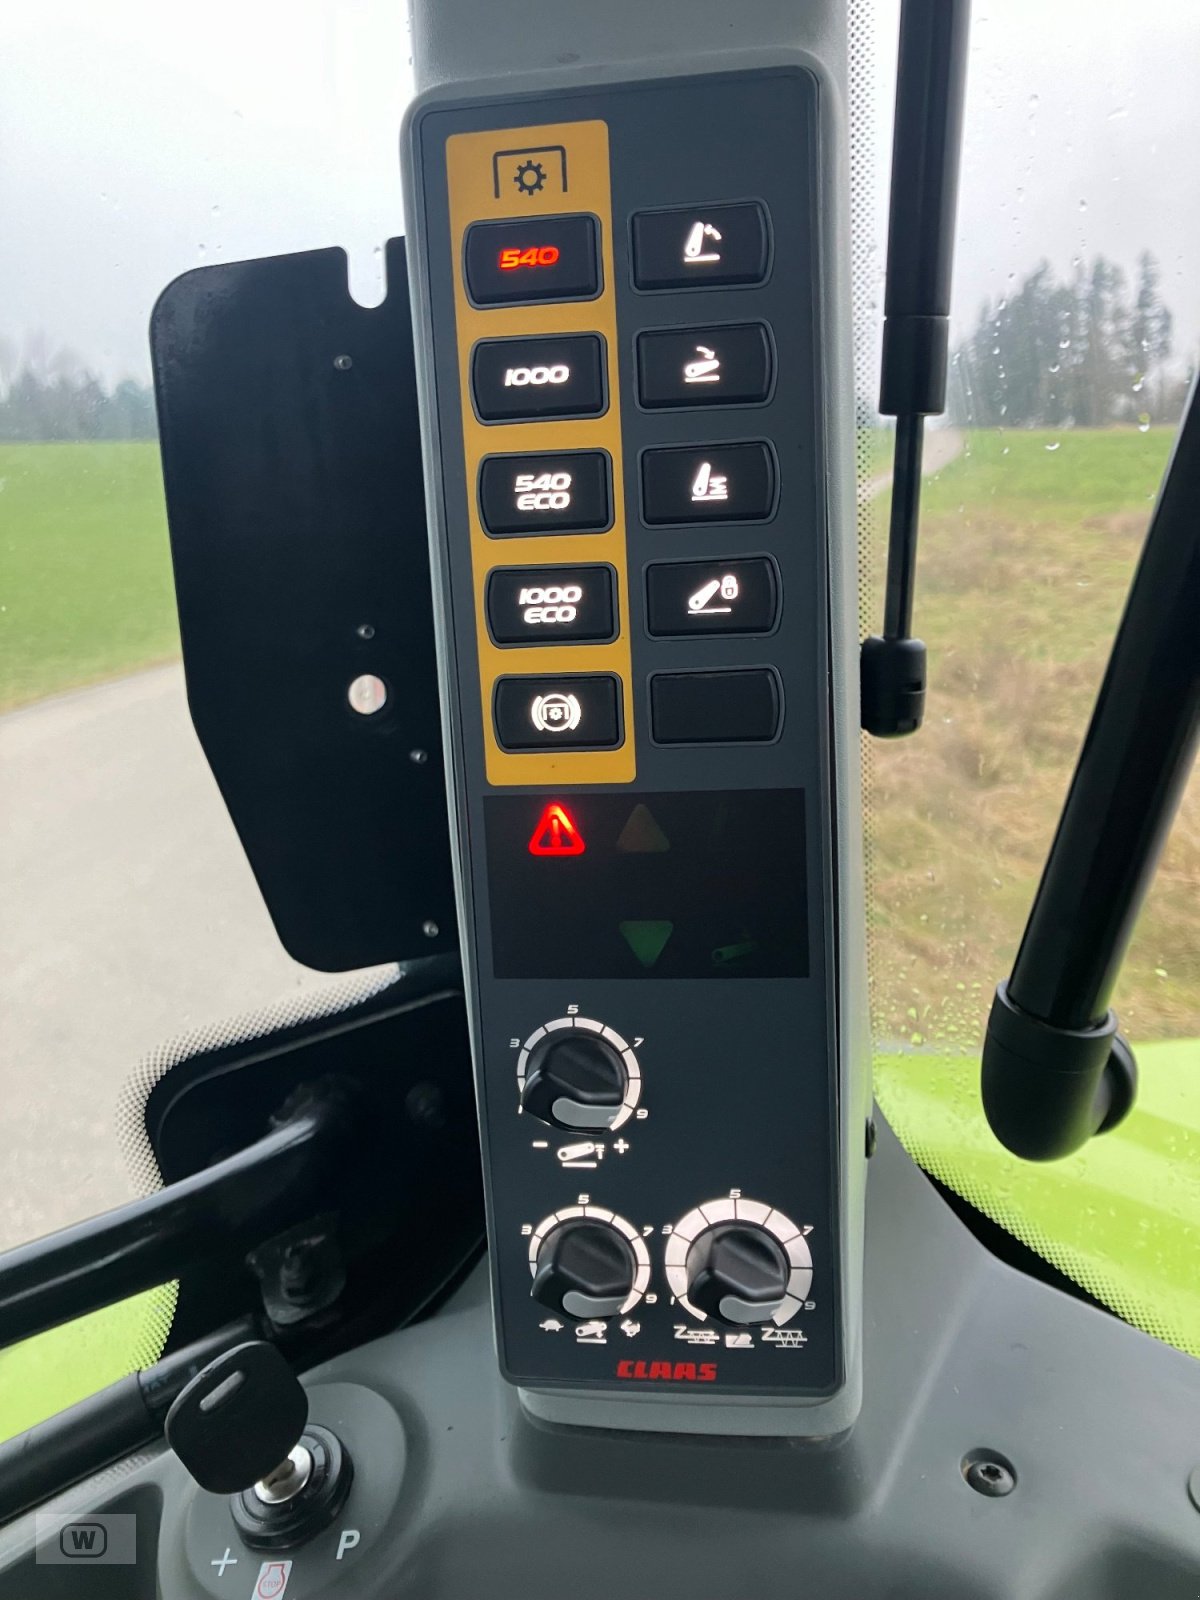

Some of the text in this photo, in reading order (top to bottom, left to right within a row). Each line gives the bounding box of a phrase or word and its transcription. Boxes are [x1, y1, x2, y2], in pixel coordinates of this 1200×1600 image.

[499, 247, 559, 270] 540
[504, 364, 570, 387] 1000
[514, 472, 572, 493] 540
[517, 492, 571, 511] ECO
[518, 585, 582, 605] 1000
[523, 605, 577, 624] ECO
[567, 1004, 579, 1014] 5
[509, 1038, 520, 1048] 3
[633, 1037, 645, 1048] 7
[635, 1108, 649, 1119] 9
[577, 1194, 590, 1204] 5
[728, 1188, 742, 1199] 5
[521, 1224, 532, 1235] 3
[642, 1226, 654, 1237] 7
[661, 1224, 674, 1235] 3
[802, 1225, 814, 1236] 7
[645, 1293, 658, 1304] 9
[804, 1301, 817, 1310] 9
[617, 1360, 717, 1381] CLAAS
[336, 1530, 360, 1560] P
